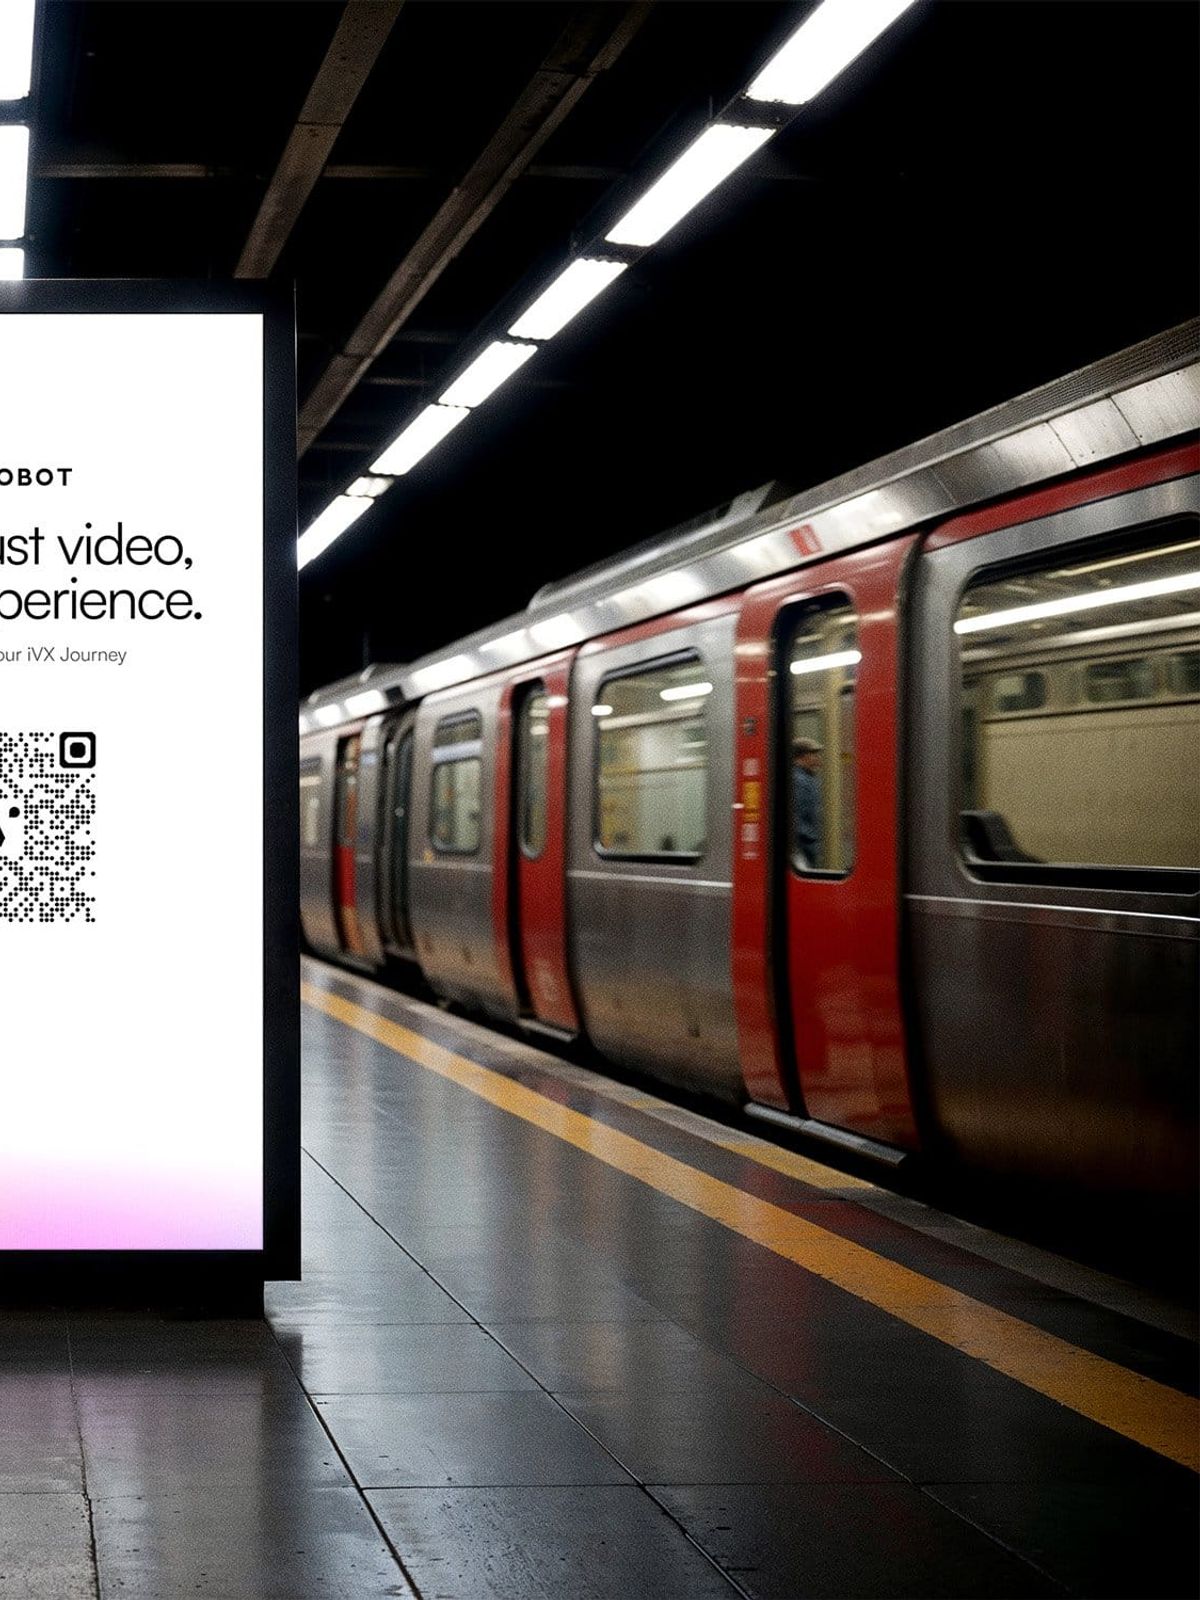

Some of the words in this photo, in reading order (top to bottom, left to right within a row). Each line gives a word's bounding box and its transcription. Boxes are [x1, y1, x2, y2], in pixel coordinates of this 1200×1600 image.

[58, 521, 194, 570] video,
[27, 646, 55, 663] iVX
[59, 646, 128, 666] Journey
